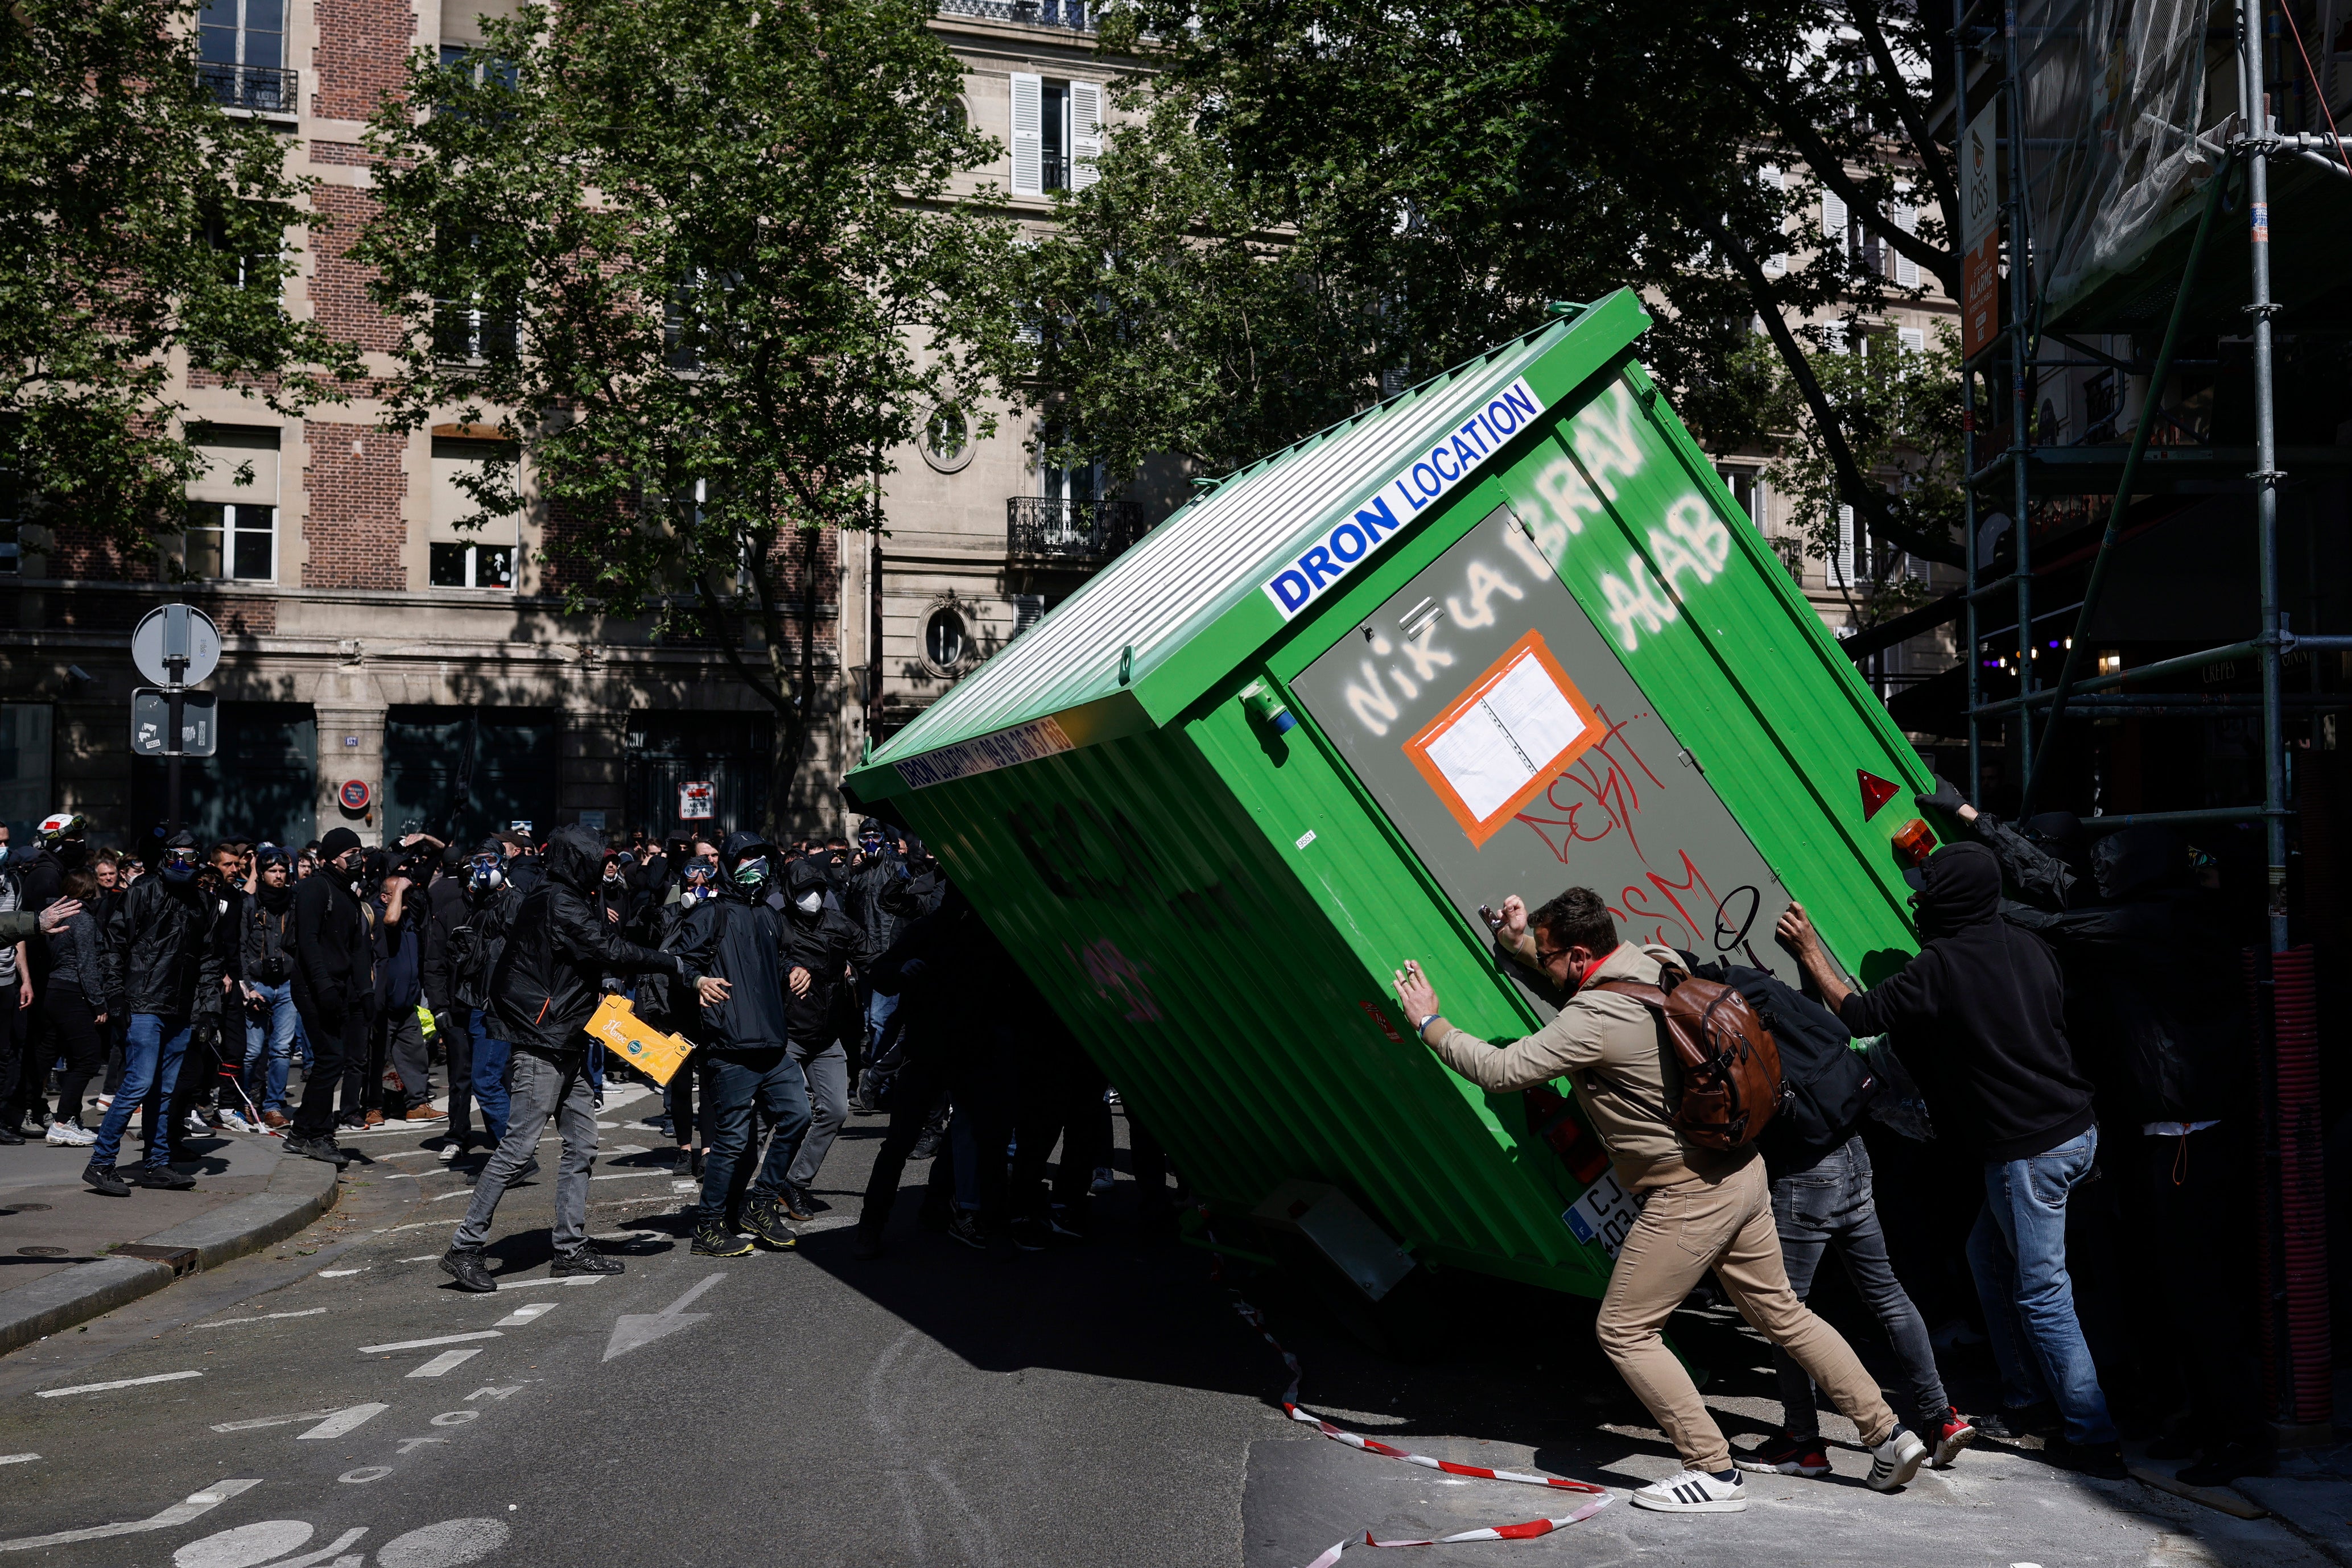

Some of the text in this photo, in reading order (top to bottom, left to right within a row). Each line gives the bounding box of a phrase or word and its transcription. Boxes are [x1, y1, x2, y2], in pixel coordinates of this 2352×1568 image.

[1970, 173, 1988, 220] bss
[1969, 266, 1993, 303] ALARME
[1269, 383, 1537, 613] DRON LOCATION
[1598, 493, 1733, 652] ACAB
[896, 720, 1071, 787] DRON LOCATION 09 69 36 37 66
[1298, 833, 1314, 847] 9551
[602, 1019, 629, 1043] Maroc
[1587, 1175, 1623, 1216] CJ
[1578, 1226, 1584, 1235] F
